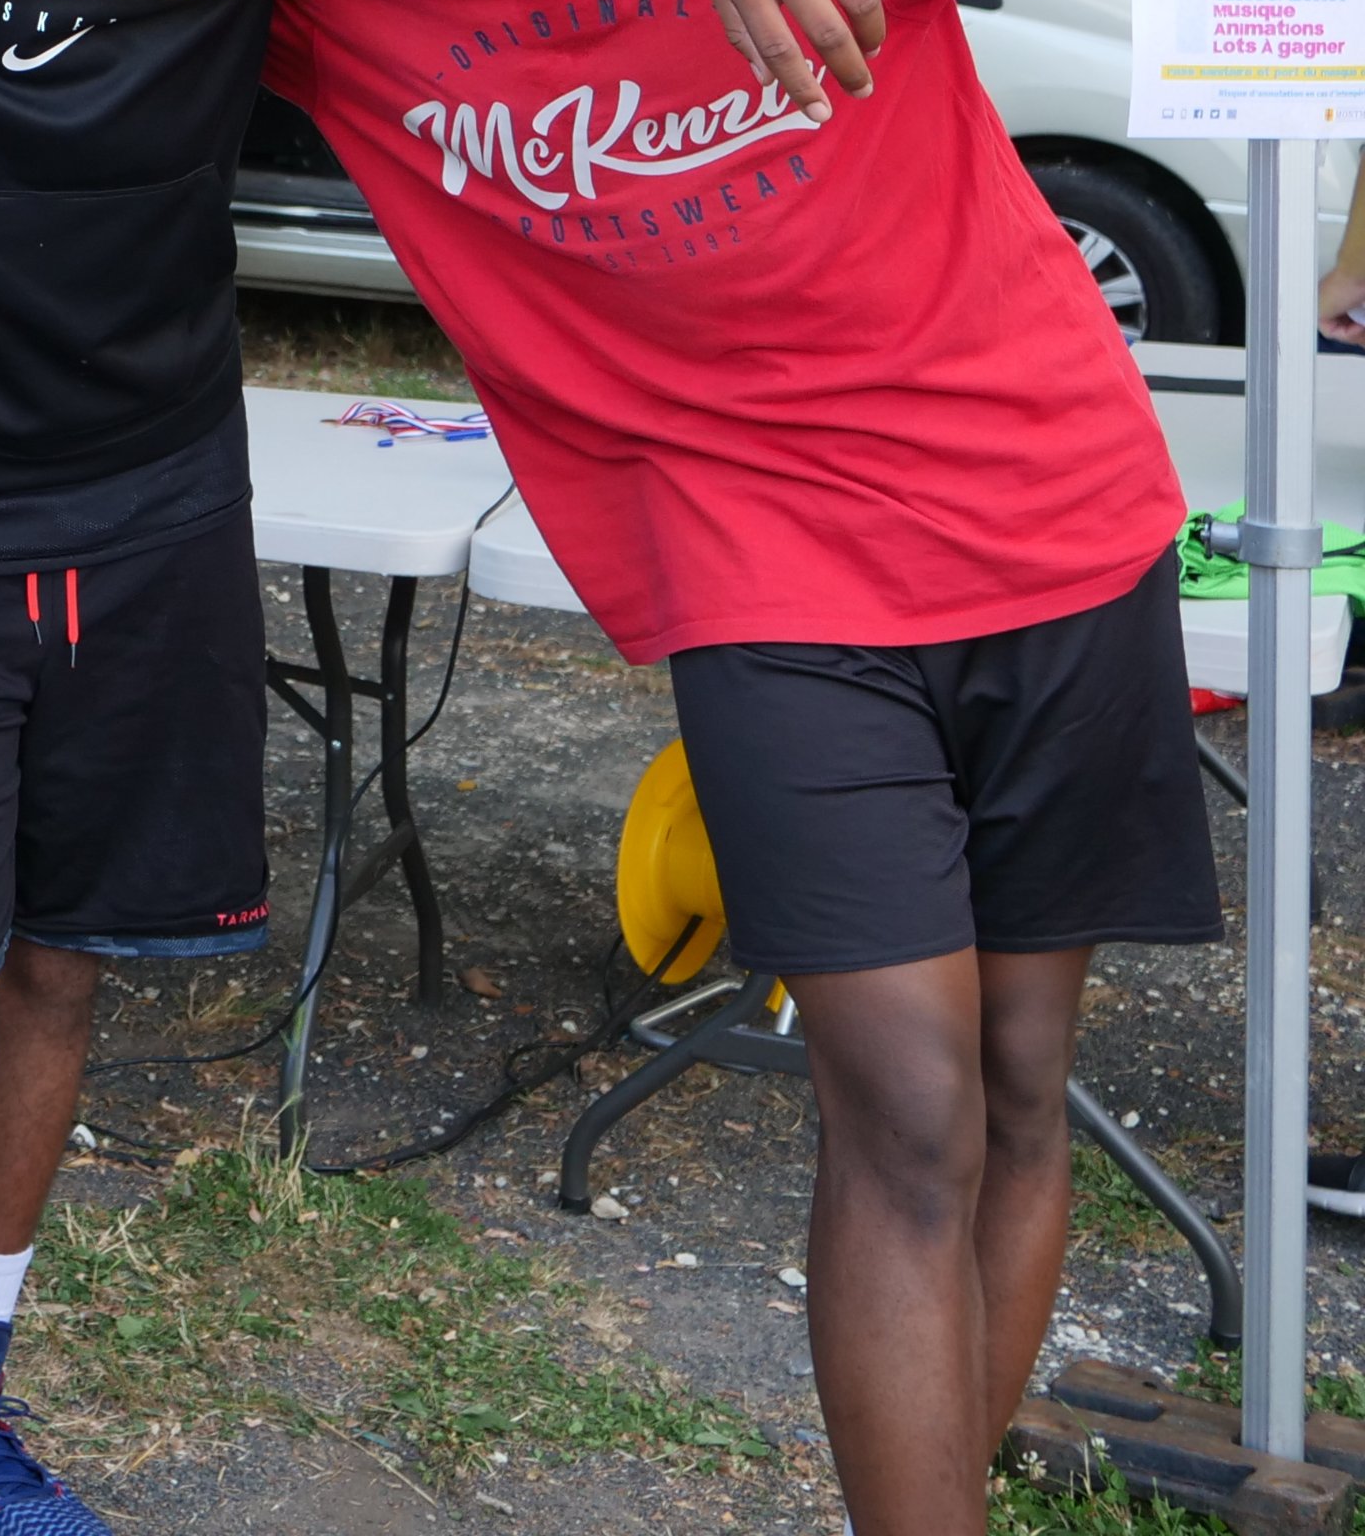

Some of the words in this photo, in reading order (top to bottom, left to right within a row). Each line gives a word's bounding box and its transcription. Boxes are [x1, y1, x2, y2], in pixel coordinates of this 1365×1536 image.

[1214, 20, 1325, 36] Animations
[1213, 38, 1257, 54] Lots
[1278, 41, 1346, 59] gagner
[661, 224, 742, 264] 1992
